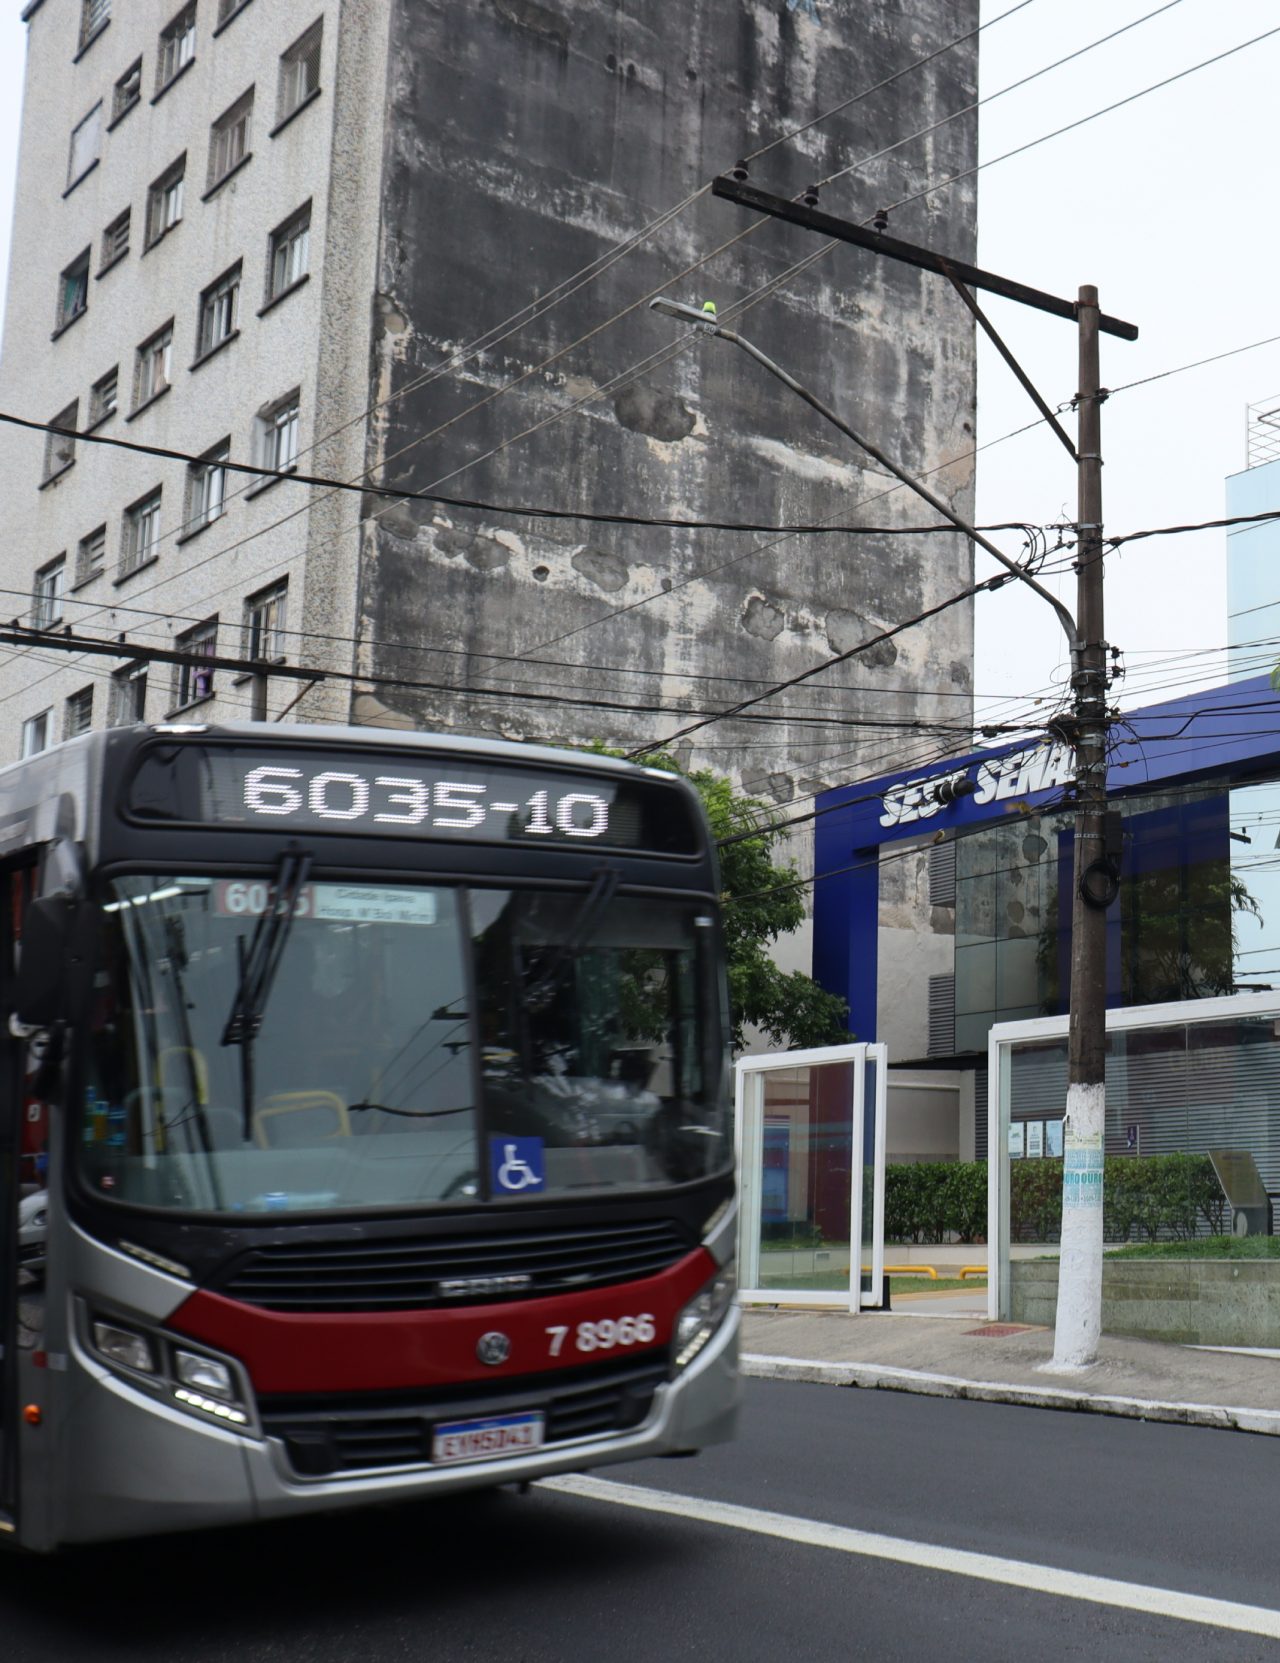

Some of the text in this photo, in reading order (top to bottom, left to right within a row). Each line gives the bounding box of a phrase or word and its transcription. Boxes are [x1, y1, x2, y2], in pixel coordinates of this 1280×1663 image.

[244, 766, 608, 836] 6035-10
[545, 1313, 656, 1356] 7 8966
